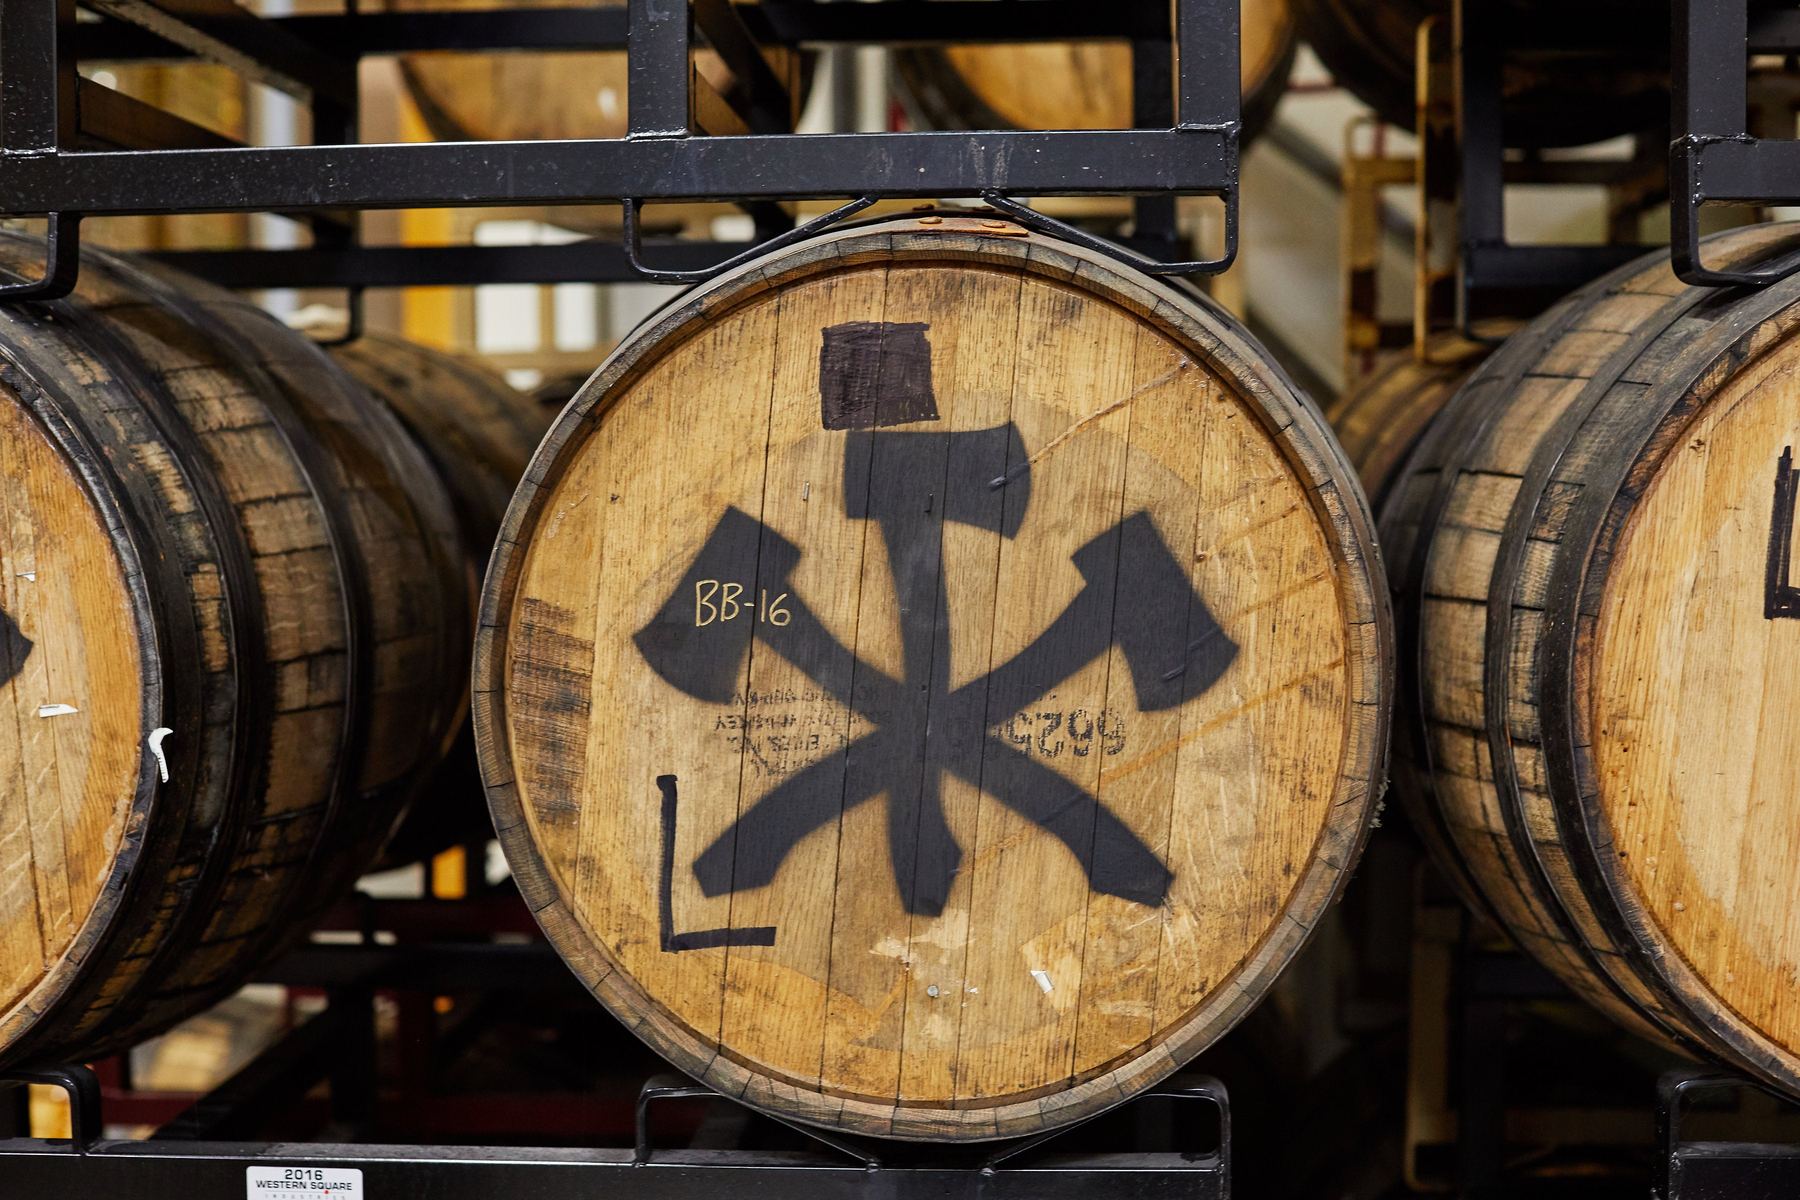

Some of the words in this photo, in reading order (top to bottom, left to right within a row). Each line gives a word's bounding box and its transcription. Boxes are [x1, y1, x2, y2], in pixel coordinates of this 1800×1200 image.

[695, 579, 791, 627] BB-16
[997, 707, 1127, 757] 6625
[256, 1180, 306, 1189] WESTERN
[311, 1181, 352, 1190] SQUARE
[285, 1169, 323, 1180] 2016
